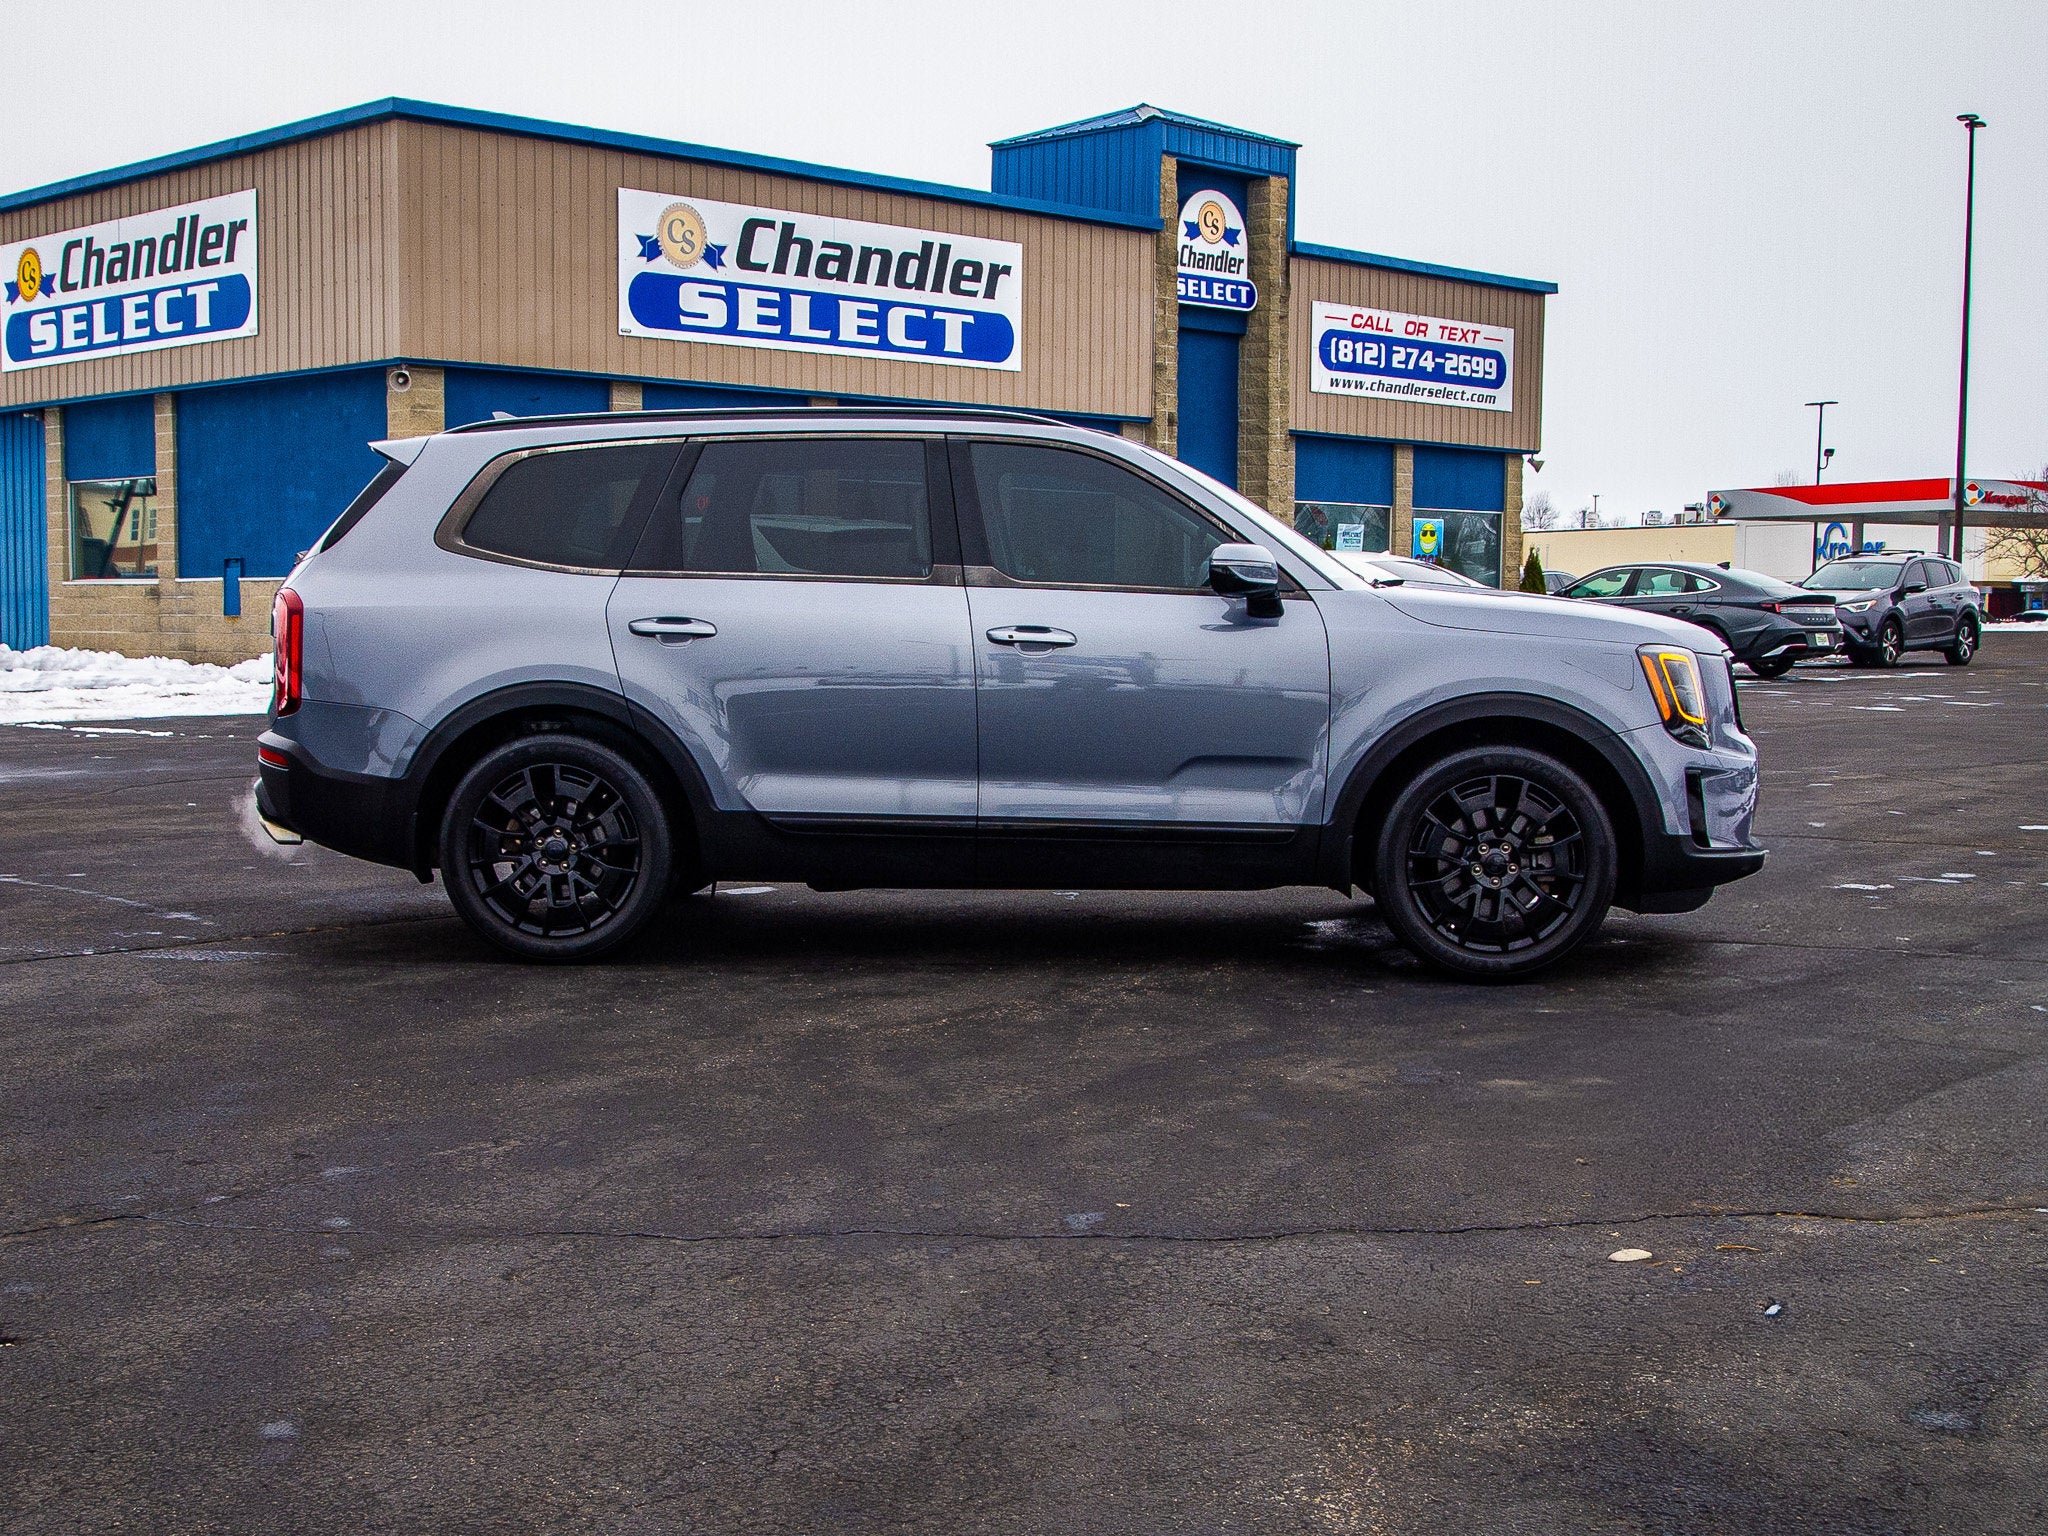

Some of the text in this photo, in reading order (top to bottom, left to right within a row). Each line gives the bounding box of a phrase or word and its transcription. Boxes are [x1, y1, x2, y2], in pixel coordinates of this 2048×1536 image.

[59, 214, 248, 293] Chandler
[735, 217, 1012, 300] Chandler
[1179, 244, 1245, 275] Chandler
[1177, 277, 1250, 304] SELECT
[29, 282, 219, 354] SELECT
[678, 282, 975, 354] SELECT
[1350, 313, 1481, 344] CALL OR TEXT
[1330, 337, 1497, 380] (812) 274-2699
[1329, 376, 1497, 405] www.chandlerselect.com
[1815, 522, 1885, 560] Kroer
